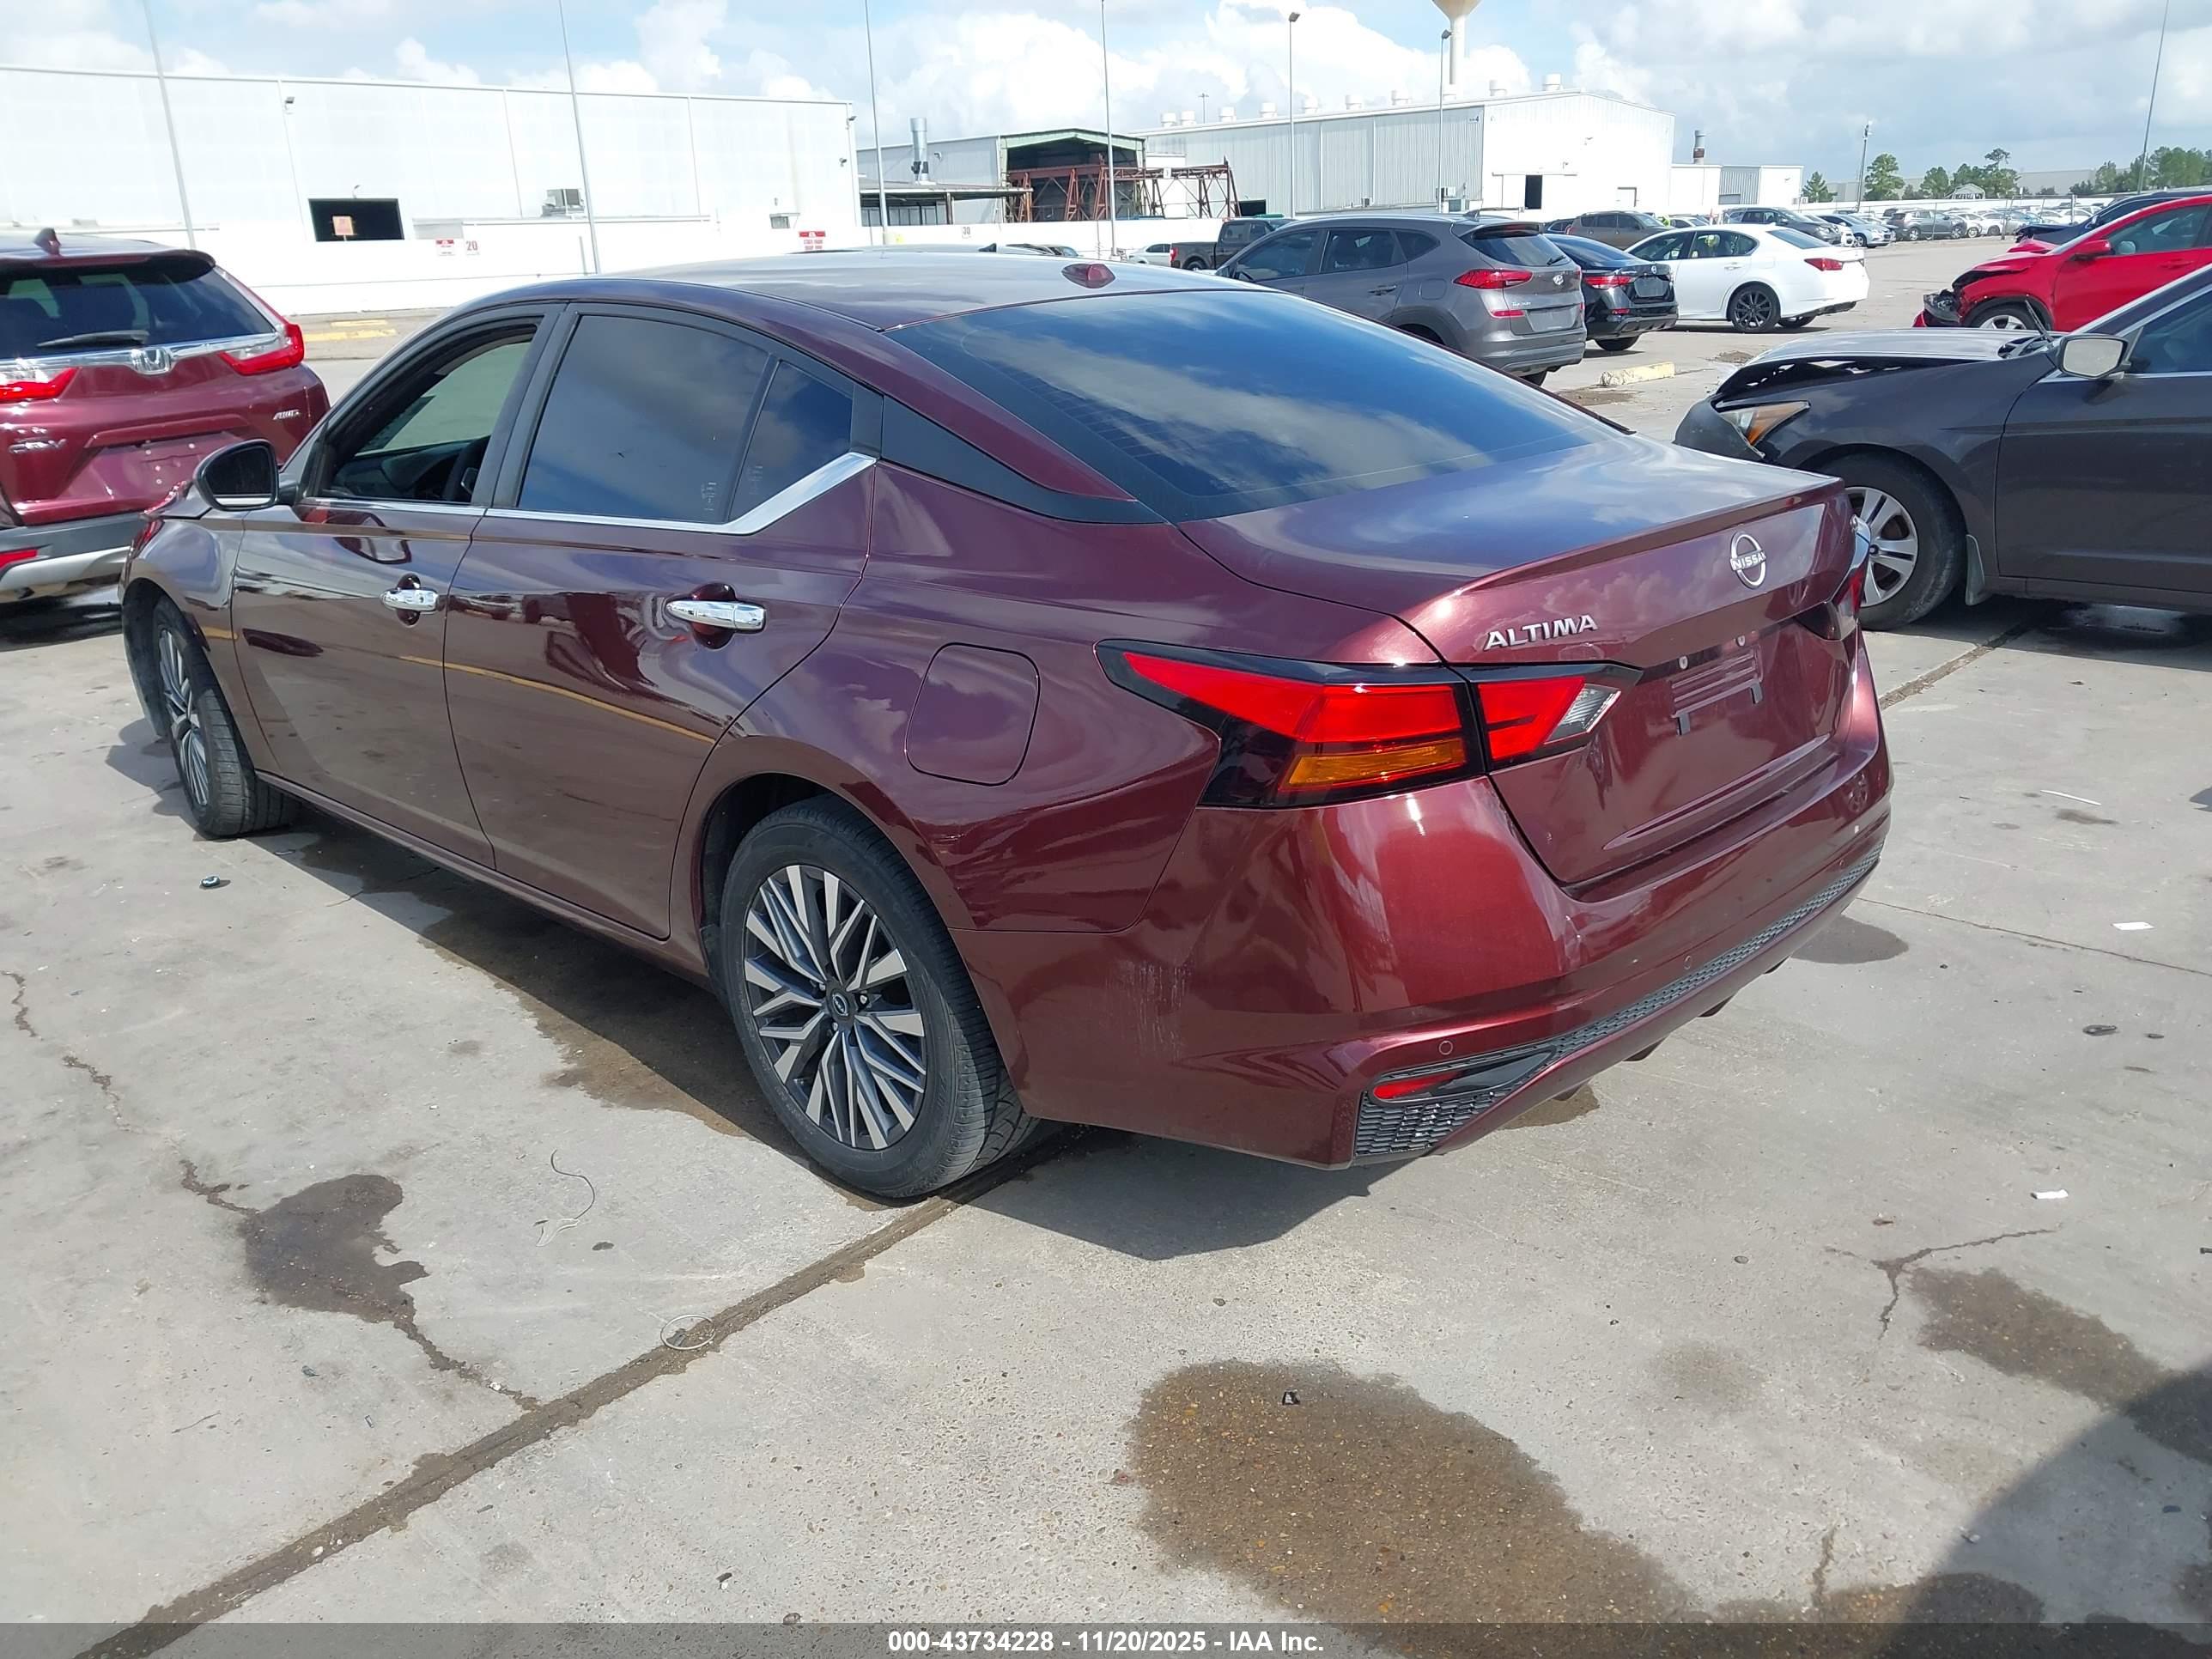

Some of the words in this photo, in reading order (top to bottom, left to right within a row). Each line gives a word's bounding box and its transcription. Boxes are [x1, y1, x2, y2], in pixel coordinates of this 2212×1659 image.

[465, 240, 478, 252] 20
[1730, 551, 1766, 570] NISSAN
[1484, 614, 1598, 651] ALTIMA
